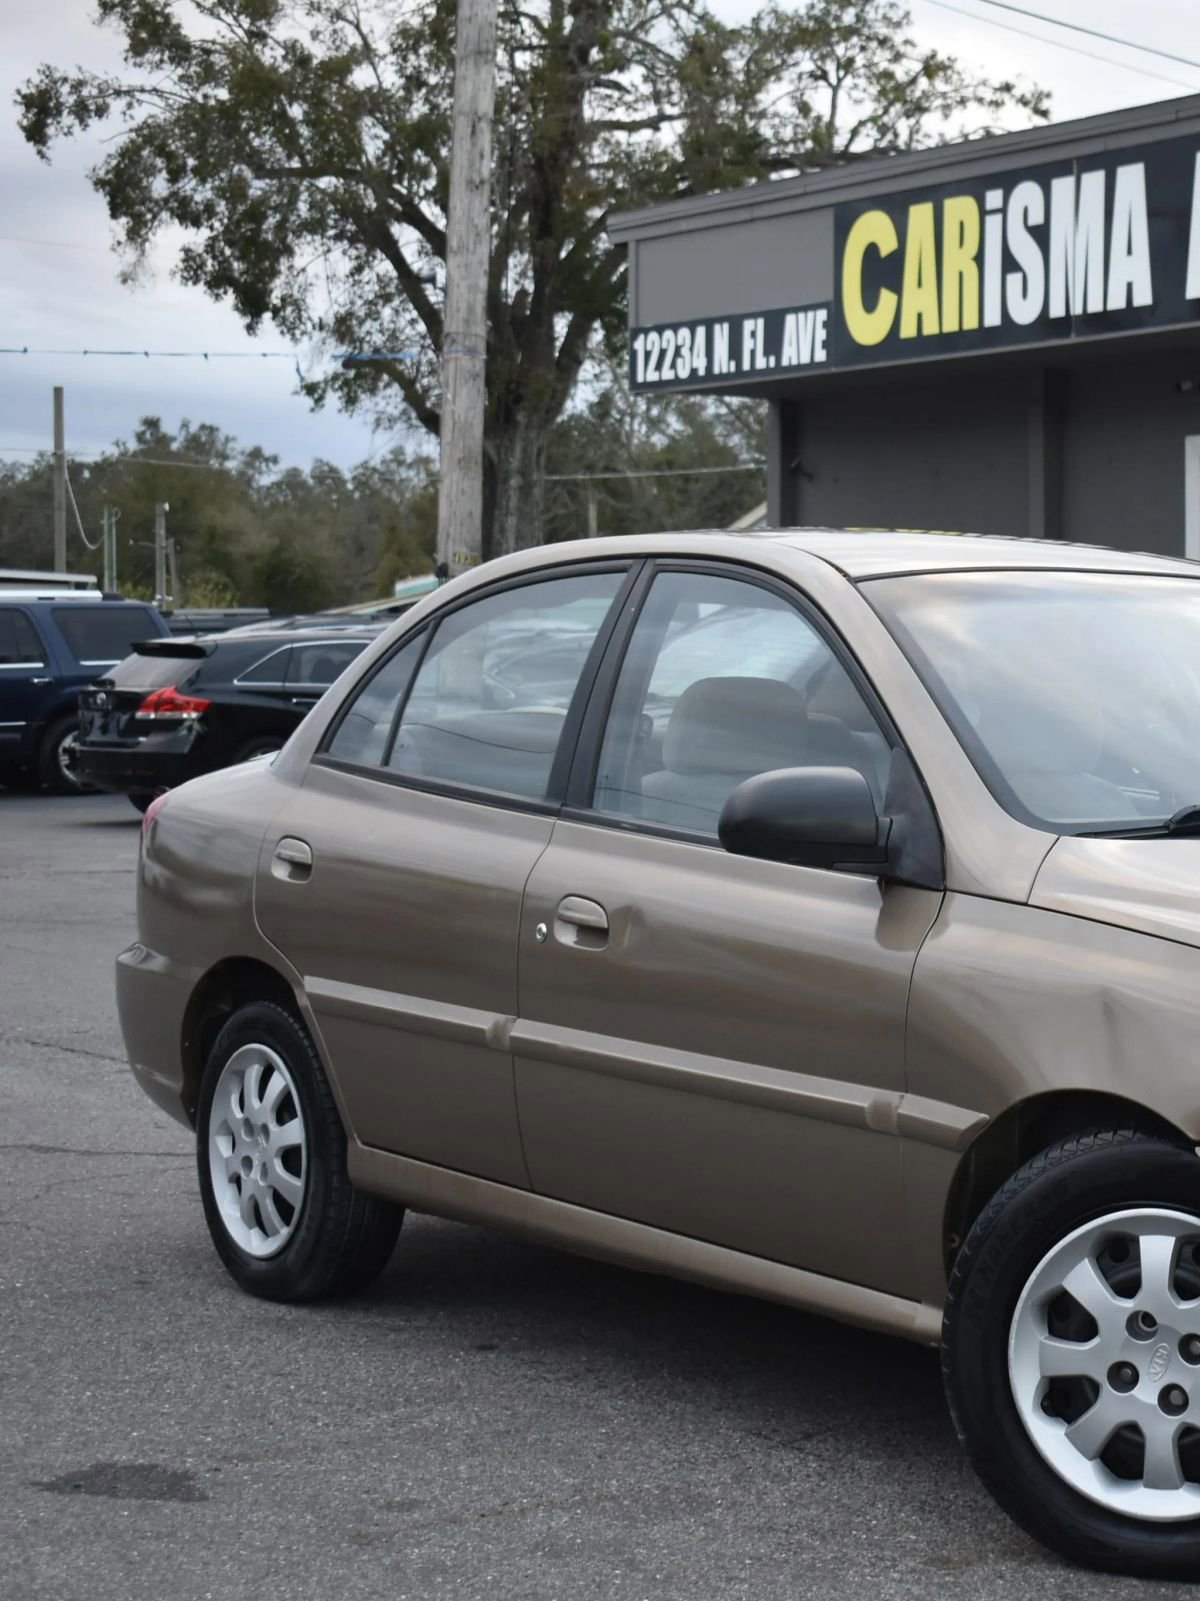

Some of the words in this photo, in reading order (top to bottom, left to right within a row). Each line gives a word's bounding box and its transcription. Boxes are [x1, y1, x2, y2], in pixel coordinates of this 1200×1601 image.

[842, 161, 1153, 347] CARiSMA
[633, 325, 708, 384] 12234
[713, 322, 736, 375] N.
[742, 317, 777, 372] FL.
[781, 308, 828, 367] AVE
